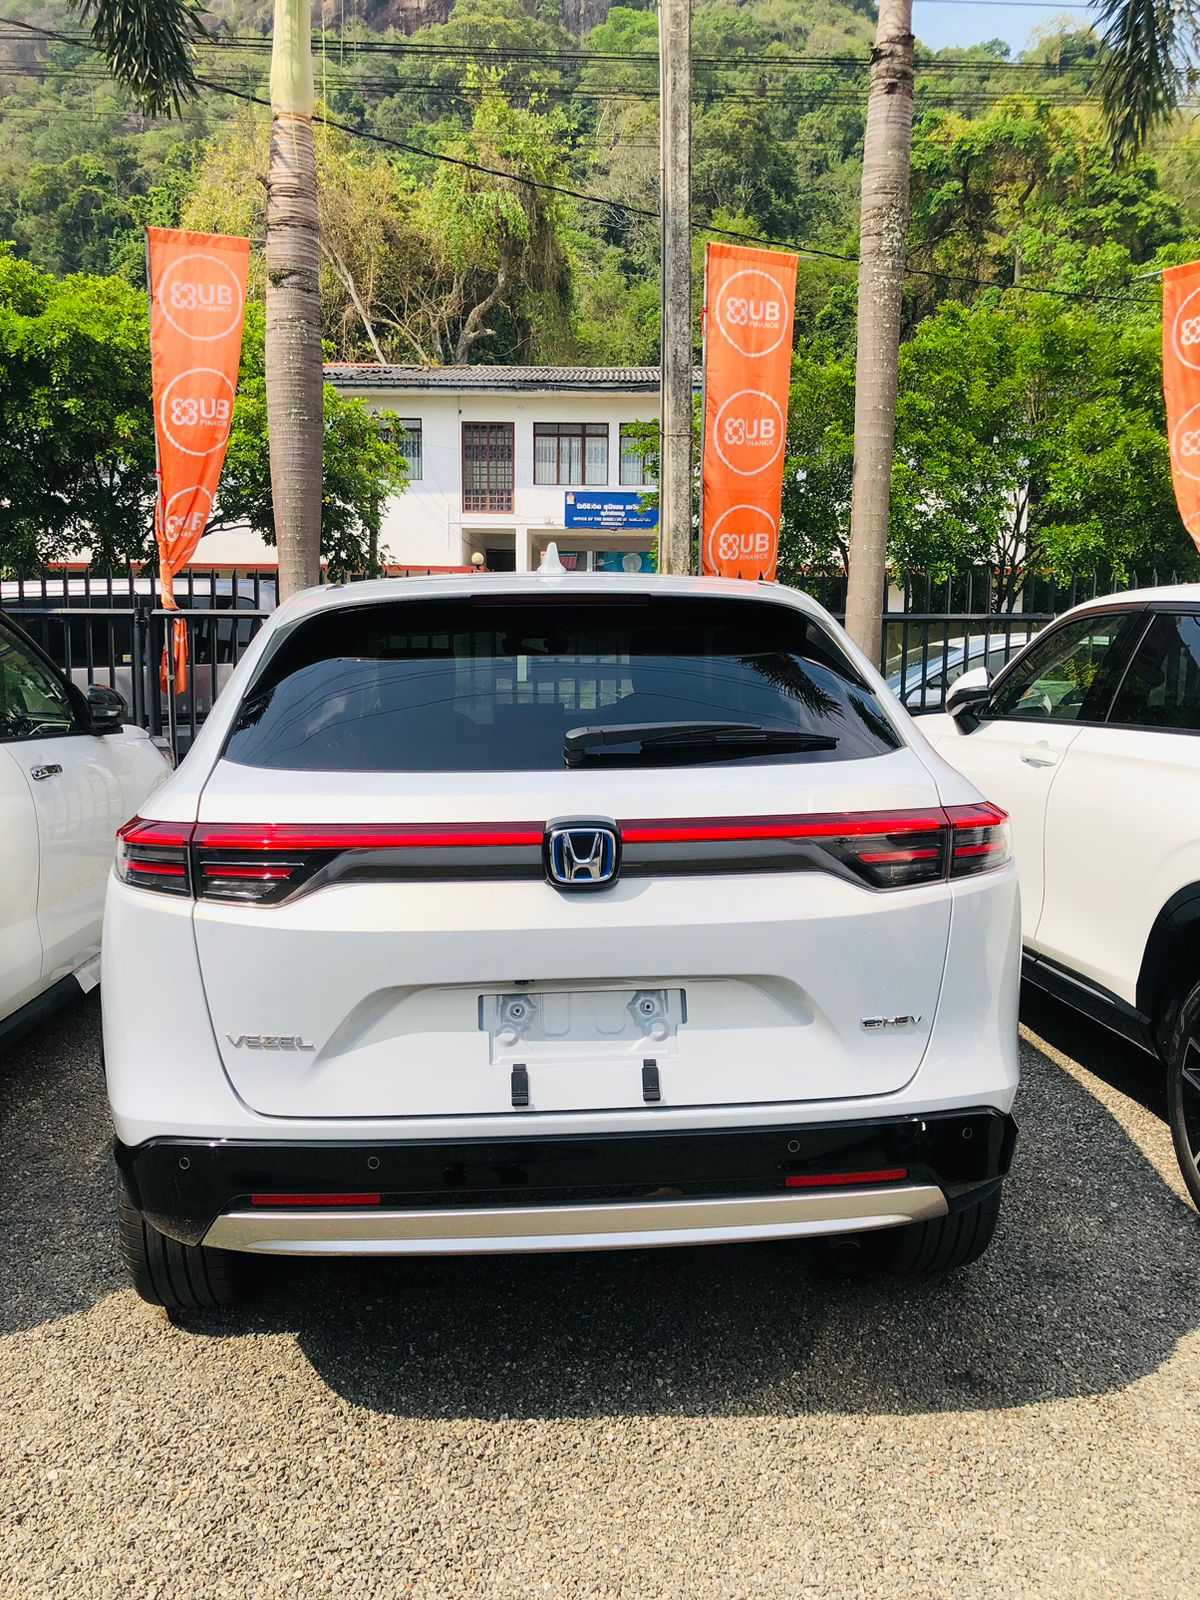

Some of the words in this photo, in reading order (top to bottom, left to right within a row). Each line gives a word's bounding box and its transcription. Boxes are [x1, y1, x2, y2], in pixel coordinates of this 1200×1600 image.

[197, 284, 233, 305] UB
[749, 300, 780, 321] UB
[200, 399, 230, 420] UB
[745, 418, 775, 440] UB
[741, 533, 770, 554] UB
[740, 552, 769, 561] FINANCE
[225, 1033, 316, 1051] VEZEL
